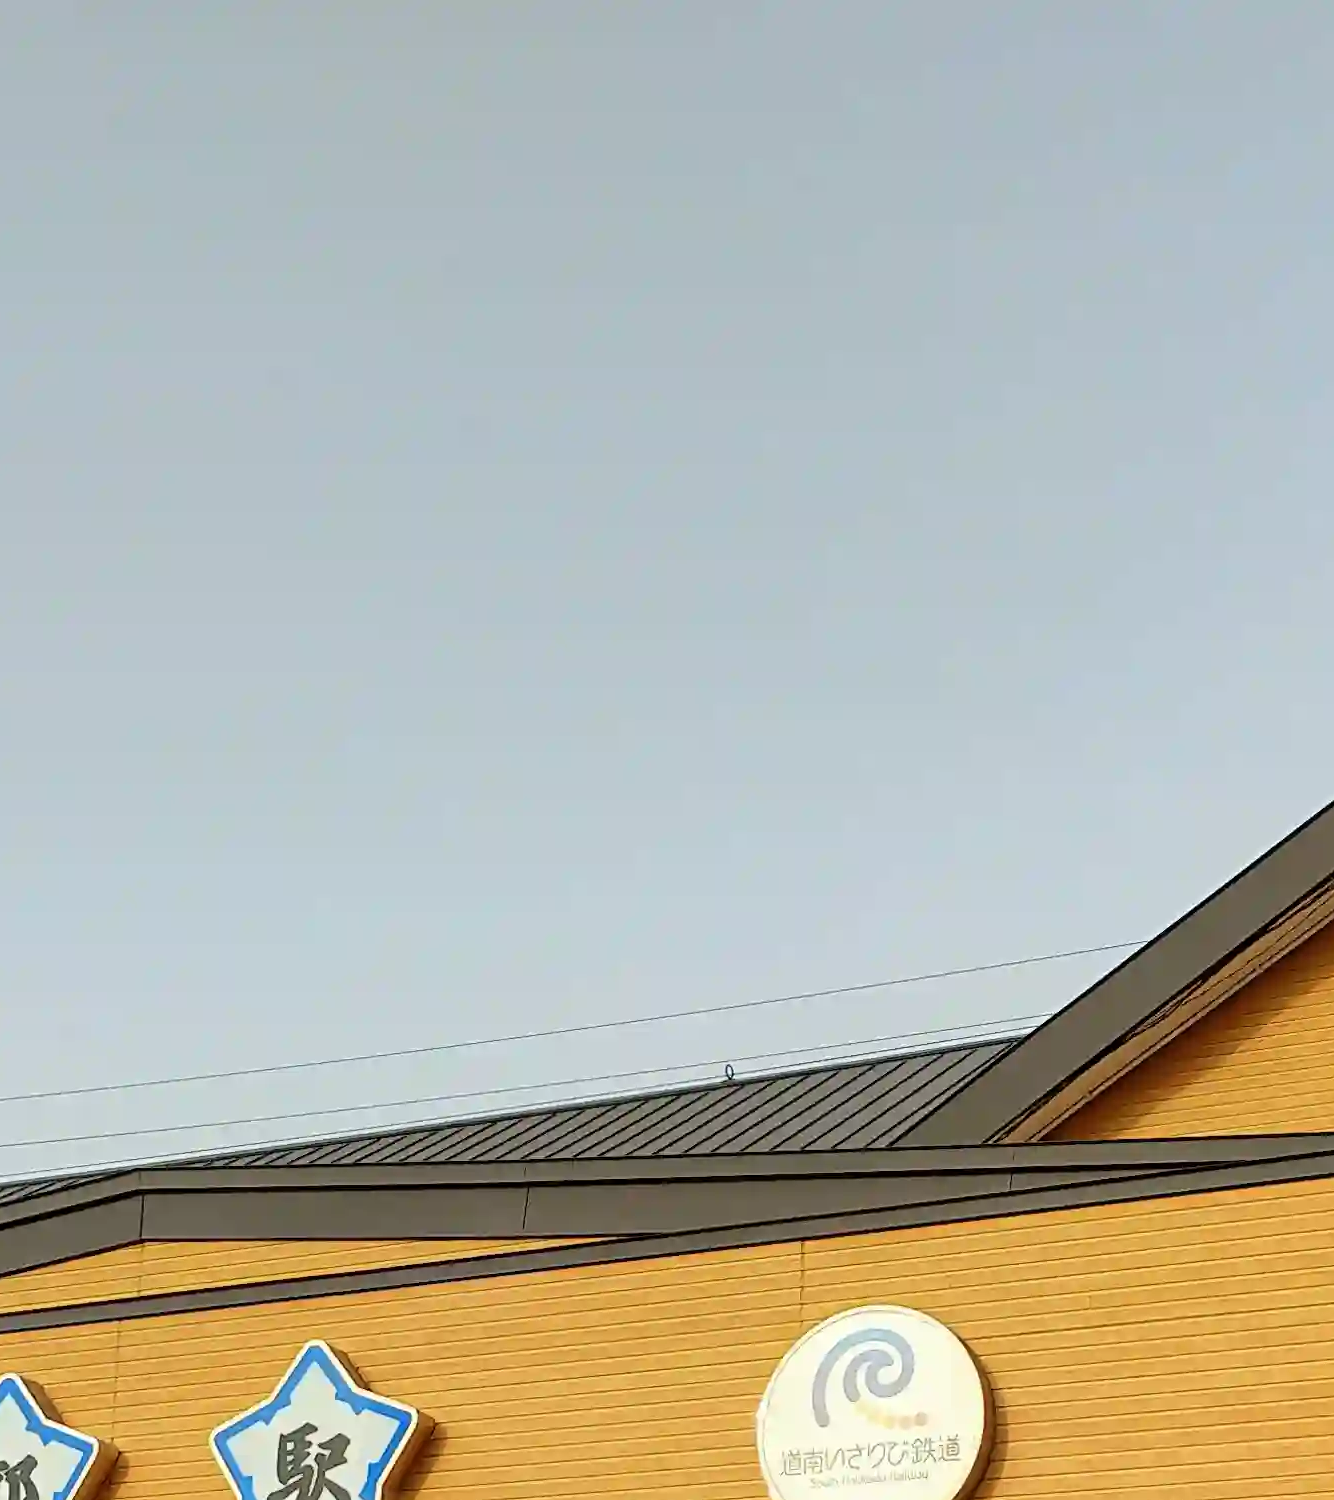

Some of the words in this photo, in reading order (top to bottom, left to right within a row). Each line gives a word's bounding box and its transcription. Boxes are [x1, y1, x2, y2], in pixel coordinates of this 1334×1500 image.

[780, 1434, 961, 1477] 道南いさりび鉄道
